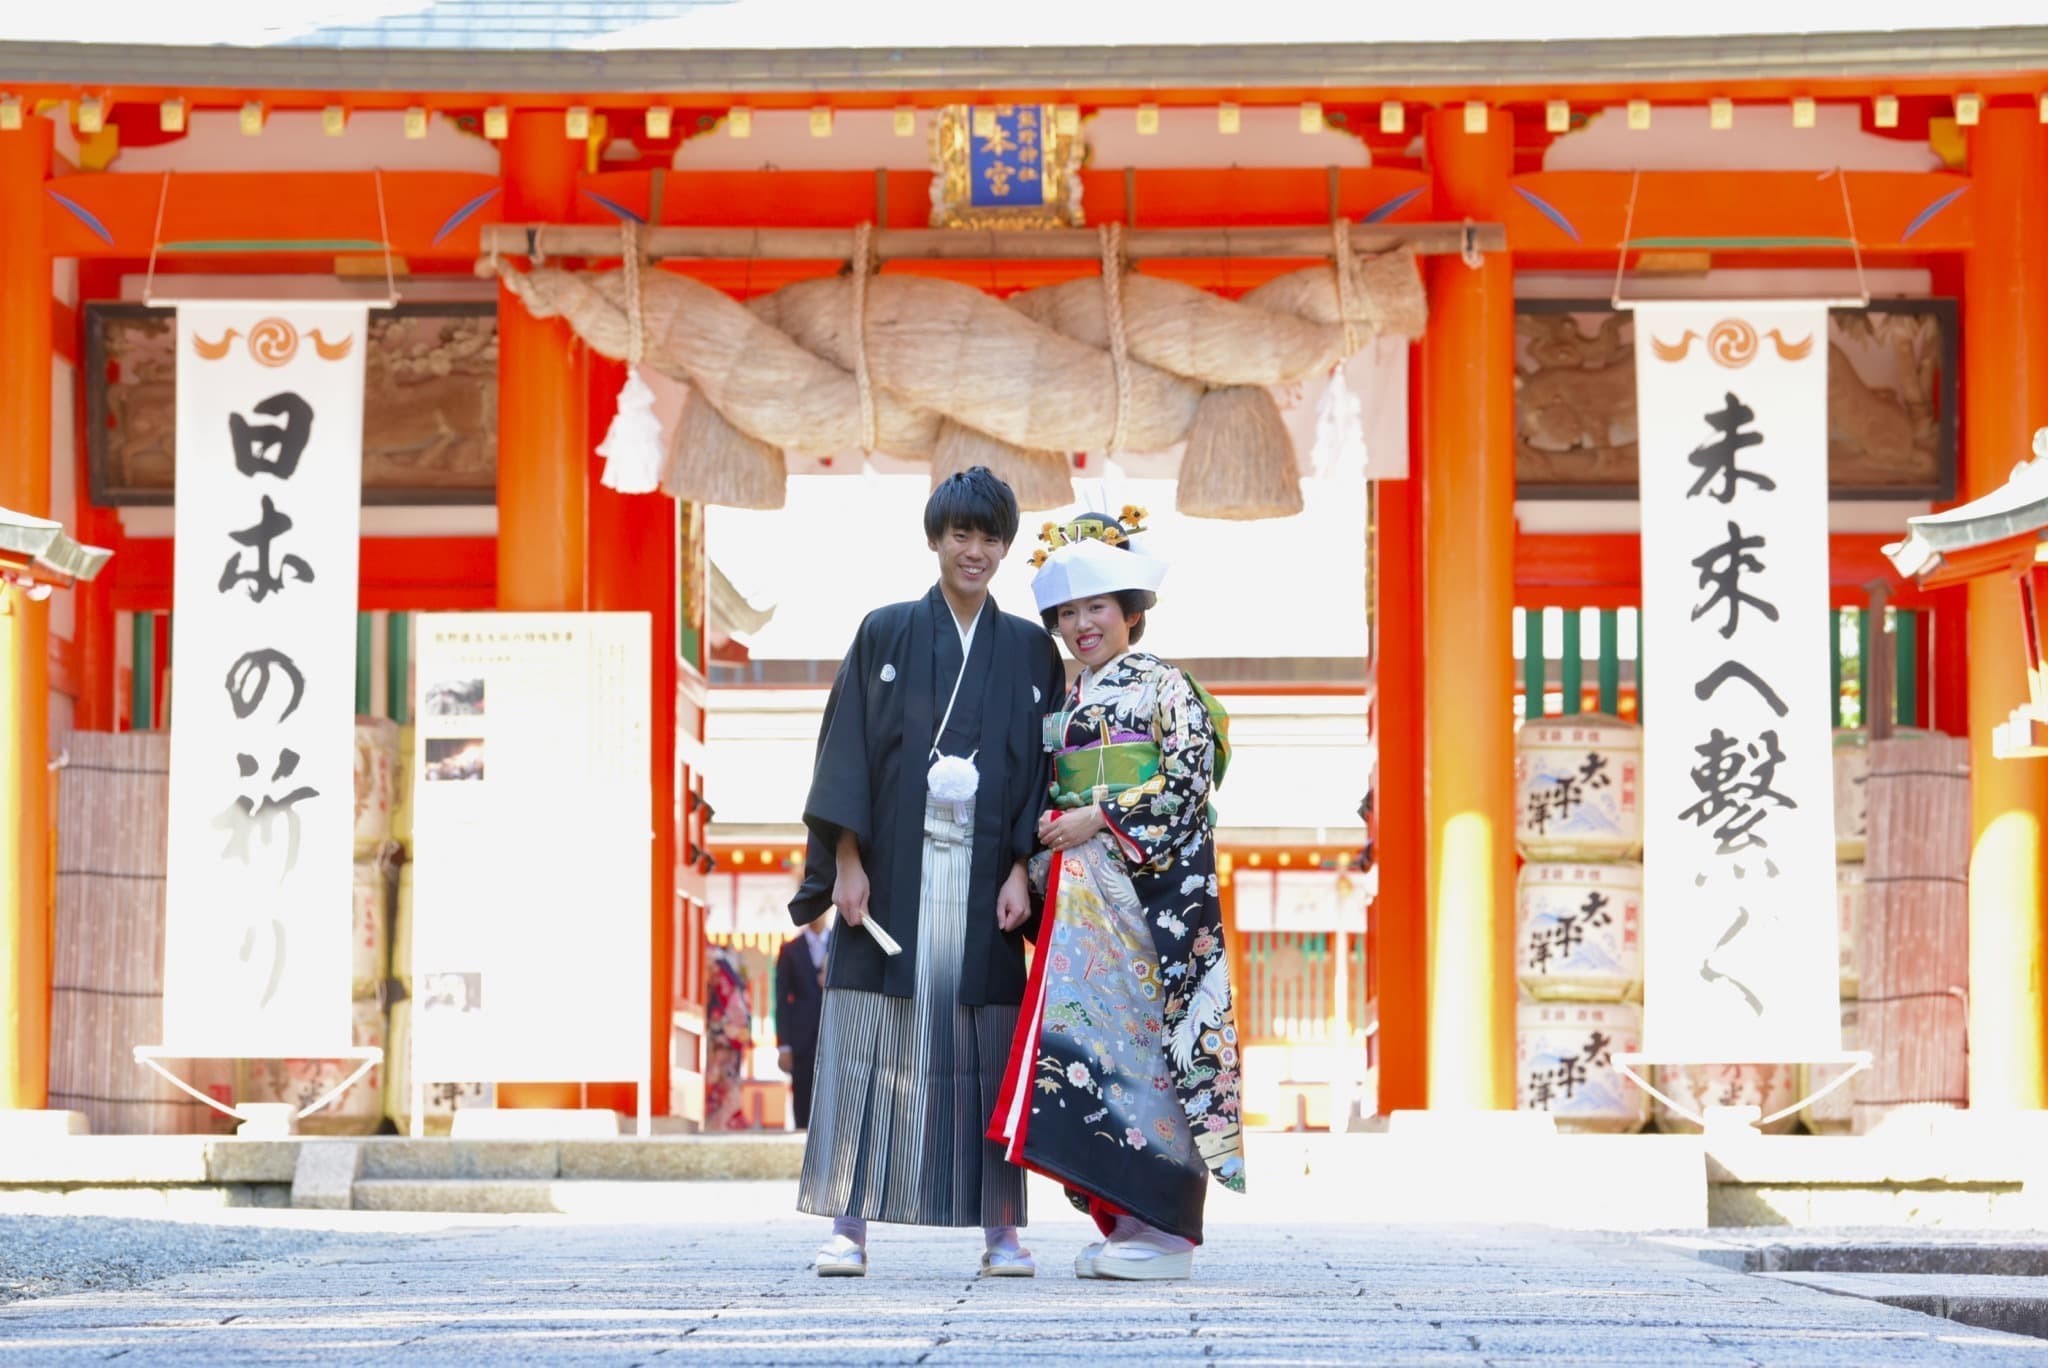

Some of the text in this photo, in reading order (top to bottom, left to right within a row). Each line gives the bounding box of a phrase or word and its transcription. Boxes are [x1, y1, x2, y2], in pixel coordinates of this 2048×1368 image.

[209, 391, 321, 1009] 日本の祈り
[1527, 751, 1612, 836] 太平洋
[1529, 891, 1612, 976] 太平洋
[1530, 1031, 1612, 1113] 太平洋
